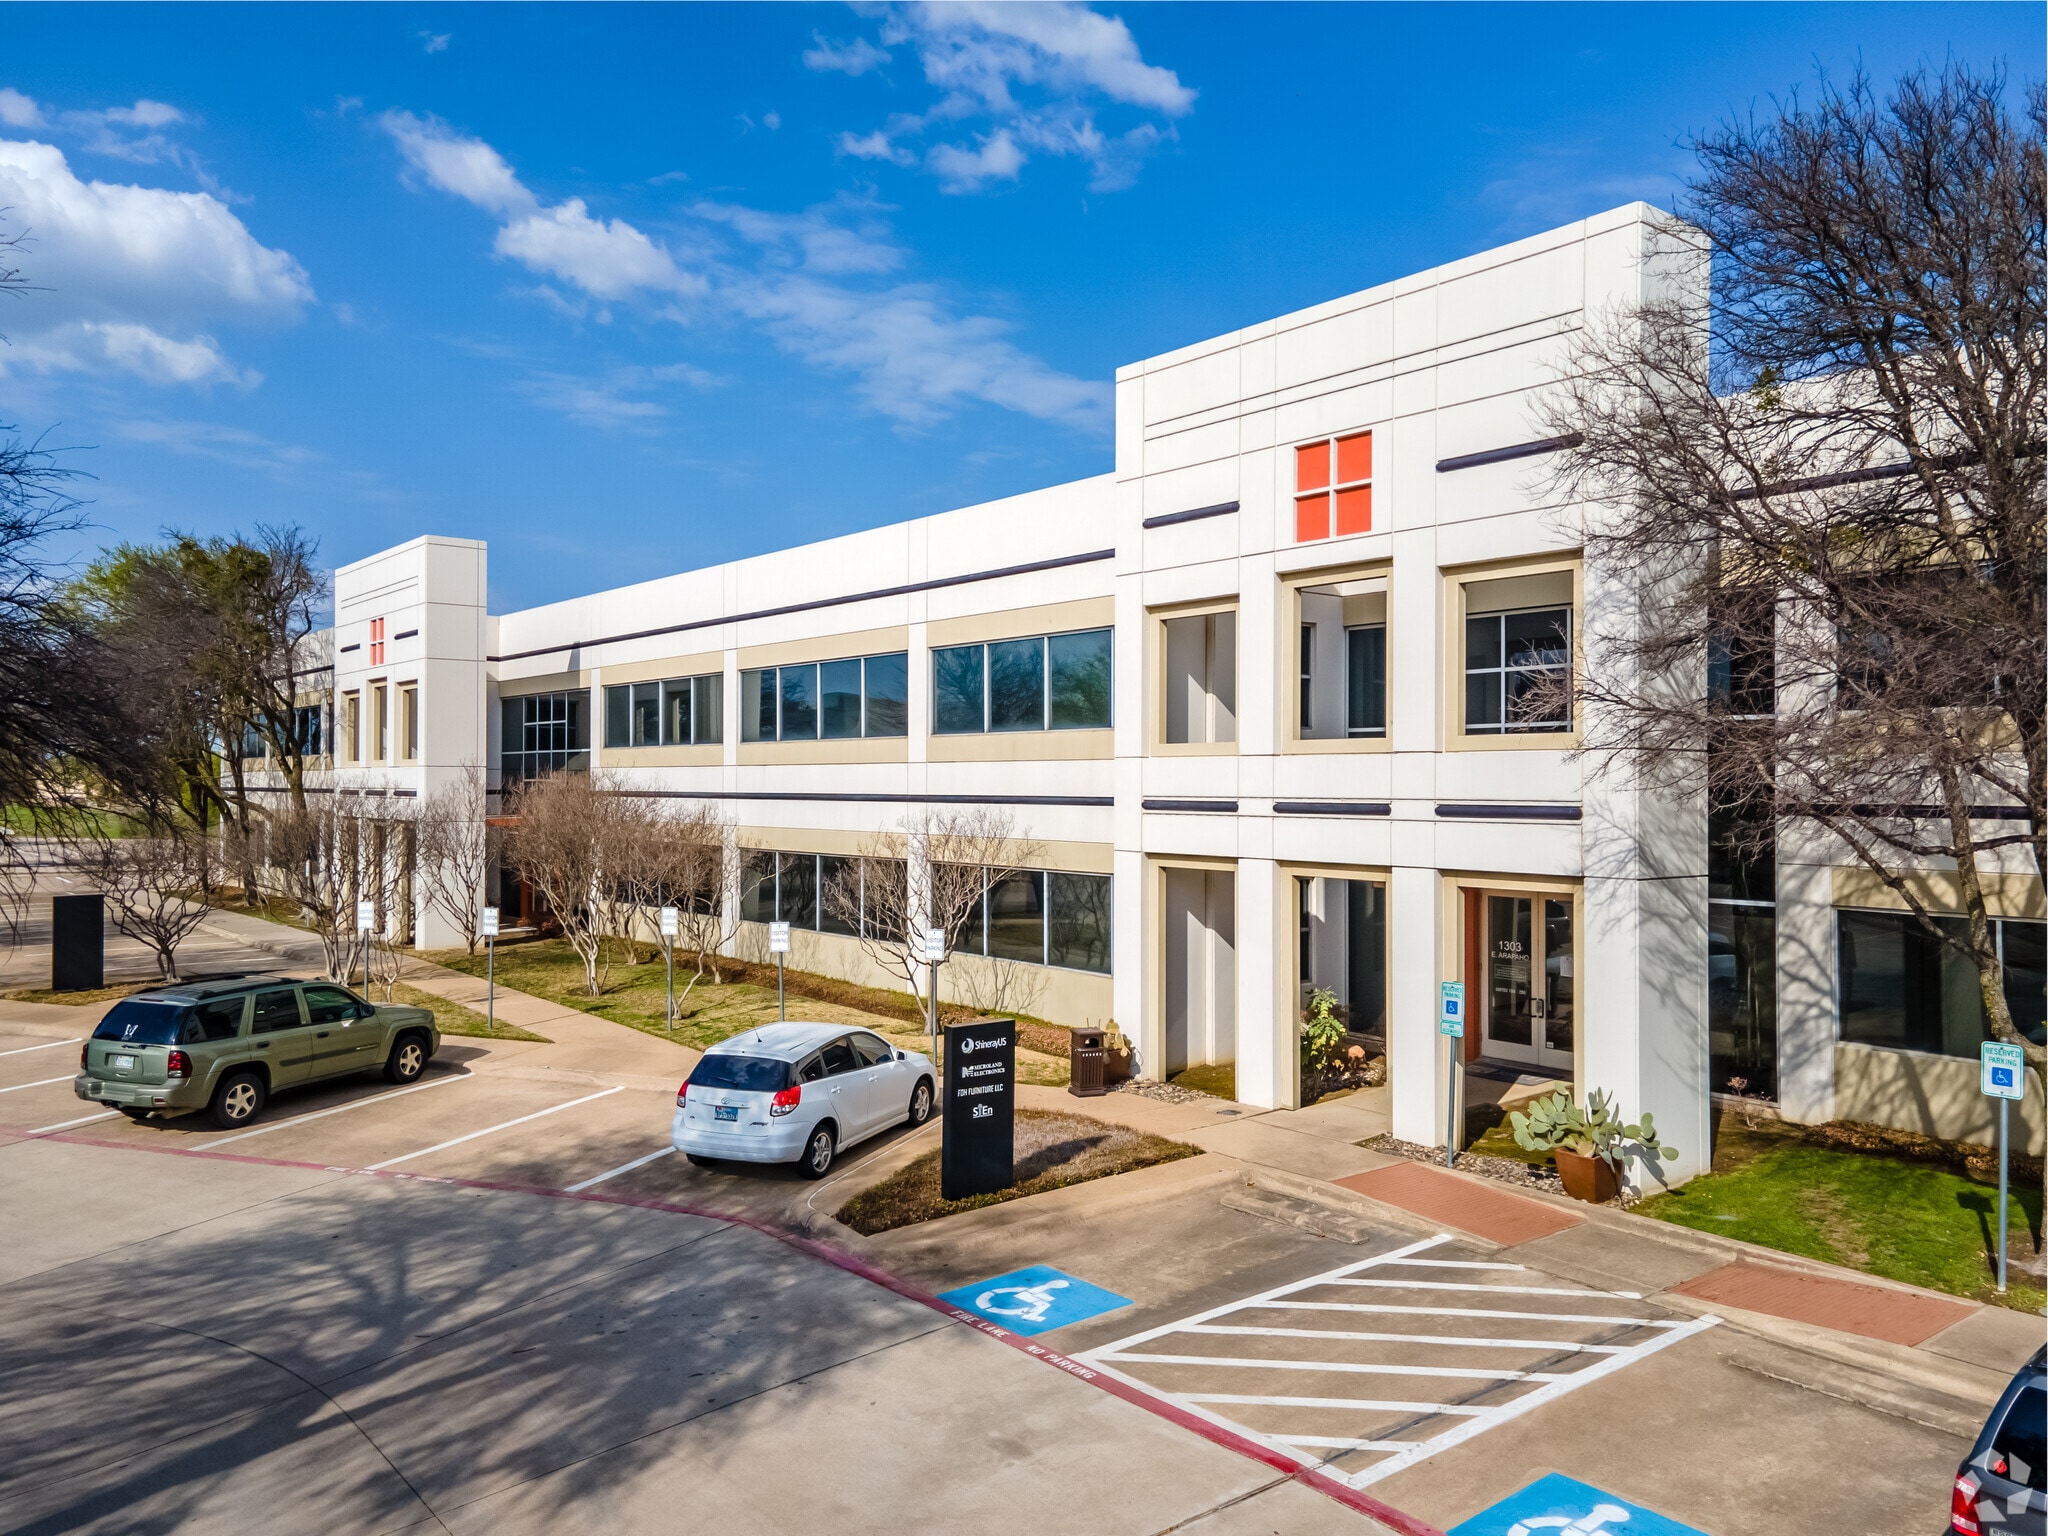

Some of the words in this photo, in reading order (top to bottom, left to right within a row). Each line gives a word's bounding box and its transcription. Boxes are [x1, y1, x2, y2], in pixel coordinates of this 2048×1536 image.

[1498, 940, 1522, 952] 1303
[1498, 952, 1530, 961] ARAPAHO
[974, 1037, 1006, 1049] ShinerayUS
[1985, 1047, 2020, 1058] RESERVED
[973, 1062, 1003, 1071] MICROLAND
[1988, 1056, 2017, 1067] PARKING
[973, 1067, 1006, 1077] ELECTRONICS
[968, 1085, 994, 1096] FURNITURE
[995, 1083, 1004, 1092] LLC
[950, 1310, 979, 1324] FIRE
[977, 1322, 1010, 1338] LANE
[1026, 1344, 1046, 1355] NO
[1045, 1353, 1098, 1380] PARKING
